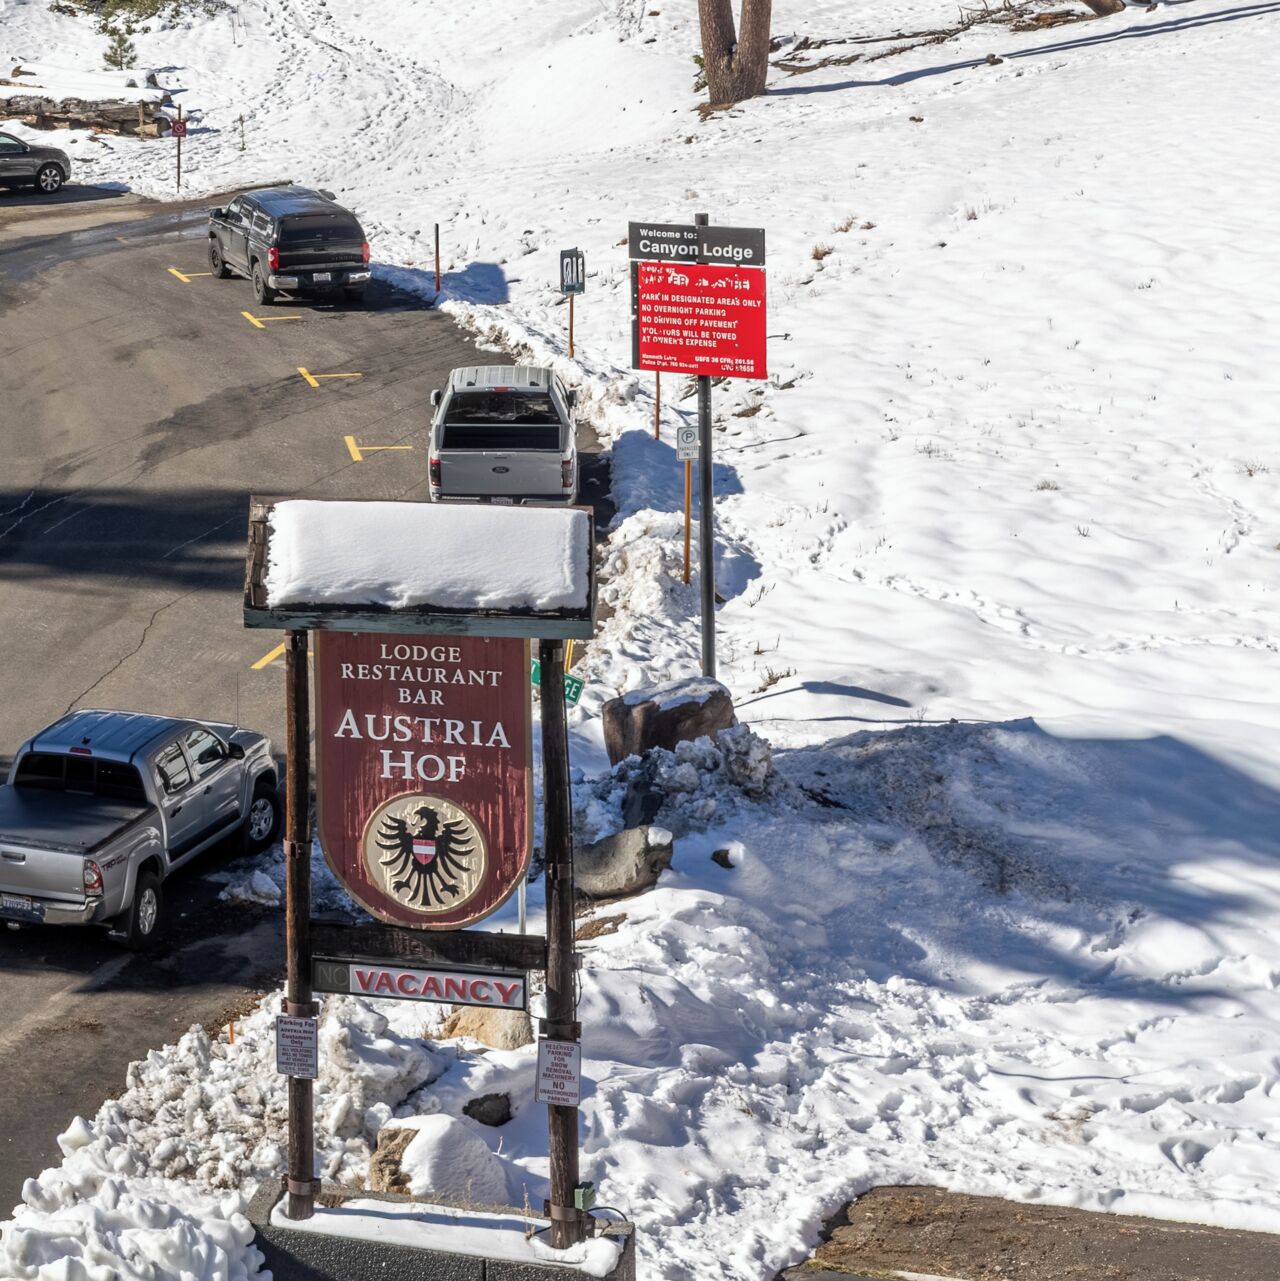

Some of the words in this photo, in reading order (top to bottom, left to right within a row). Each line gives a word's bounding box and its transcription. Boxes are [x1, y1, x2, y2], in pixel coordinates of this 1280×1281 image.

[640, 229, 680, 239] Welcome
[683, 232, 698, 240] to:
[639, 240, 699, 257] Canyon
[703, 243, 753, 259] Lodge
[642, 293, 659, 301] PARK
[671, 295, 714, 305] DESIGNATED
[717, 297, 740, 306] AREAS
[742, 299, 761, 308] ONLY
[654, 305, 693, 315] OVERNIGHT
[695, 308, 726, 316] PARKING
[654, 316, 682, 325] DRIVING
[684, 318, 697, 326] OFF
[700, 320, 737, 329] PAVEMENT
[642, 327, 680, 336] VOLTORS
[682, 330, 699, 338] WILL
[712, 332, 737, 340] TOWED
[642, 335, 650, 343] AT
[686, 339, 717, 348] EXPENSE
[380, 643, 461, 663] LODGE
[341, 663, 502, 687] RESTAURANT
[398, 688, 444, 706] BAR
[334, 709, 511, 749] AUSTRIA
[380, 750, 467, 783] HOF
[318, 966, 348, 986] NO
[355, 969, 521, 1004] VACANCY
[280, 1019, 303, 1028] Parking
[546, 1044, 574, 1052] RESERVED
[543, 1072, 576, 1081] MACHINERY
[546, 1067, 573, 1075] REMOVAL
[553, 1081, 565, 1090] NO
[540, 1089, 577, 1097] UNAUTHORIZED
